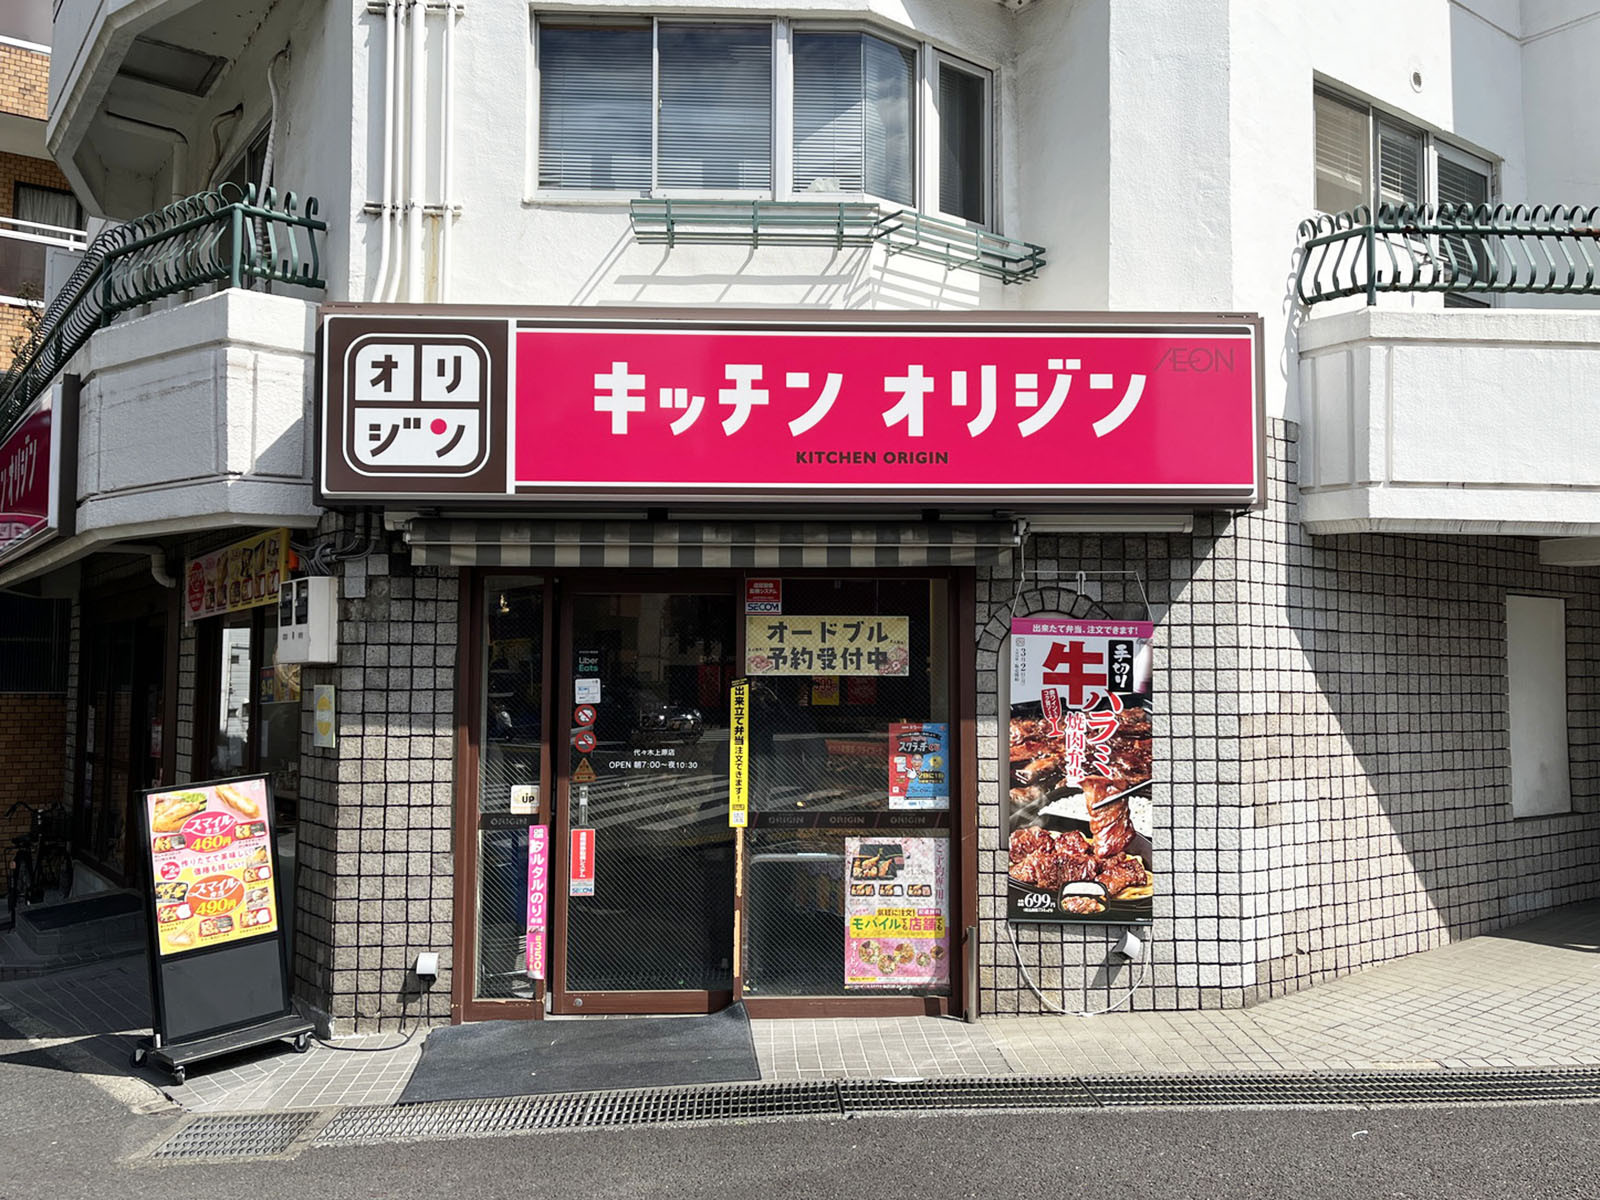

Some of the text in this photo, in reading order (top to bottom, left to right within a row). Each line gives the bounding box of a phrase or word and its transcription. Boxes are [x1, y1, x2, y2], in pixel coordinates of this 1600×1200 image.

[593, 358, 1147, 438] キッチン オリジン
[796, 451, 949, 465] KITCHEN ORIGIN
[747, 602, 779, 611] SECOM
[766, 620, 889, 644] オードブル
[578, 656, 599, 664] Uber
[766, 647, 889, 671] 予約受付中
[578, 664, 599, 672] Eats
[1111, 643, 1132, 688] 手切り
[1042, 640, 1107, 706] 牛
[633, 749, 675, 757] 代々木上原店
[608, 761, 631, 769] OPEN
[768, 816, 804, 824] ORIGIN
[829, 816, 865, 824] ORIGIN
[890, 816, 926, 824] ORIGIN
[191, 835, 232, 851] 460円
[195, 898, 237, 914] 490円
